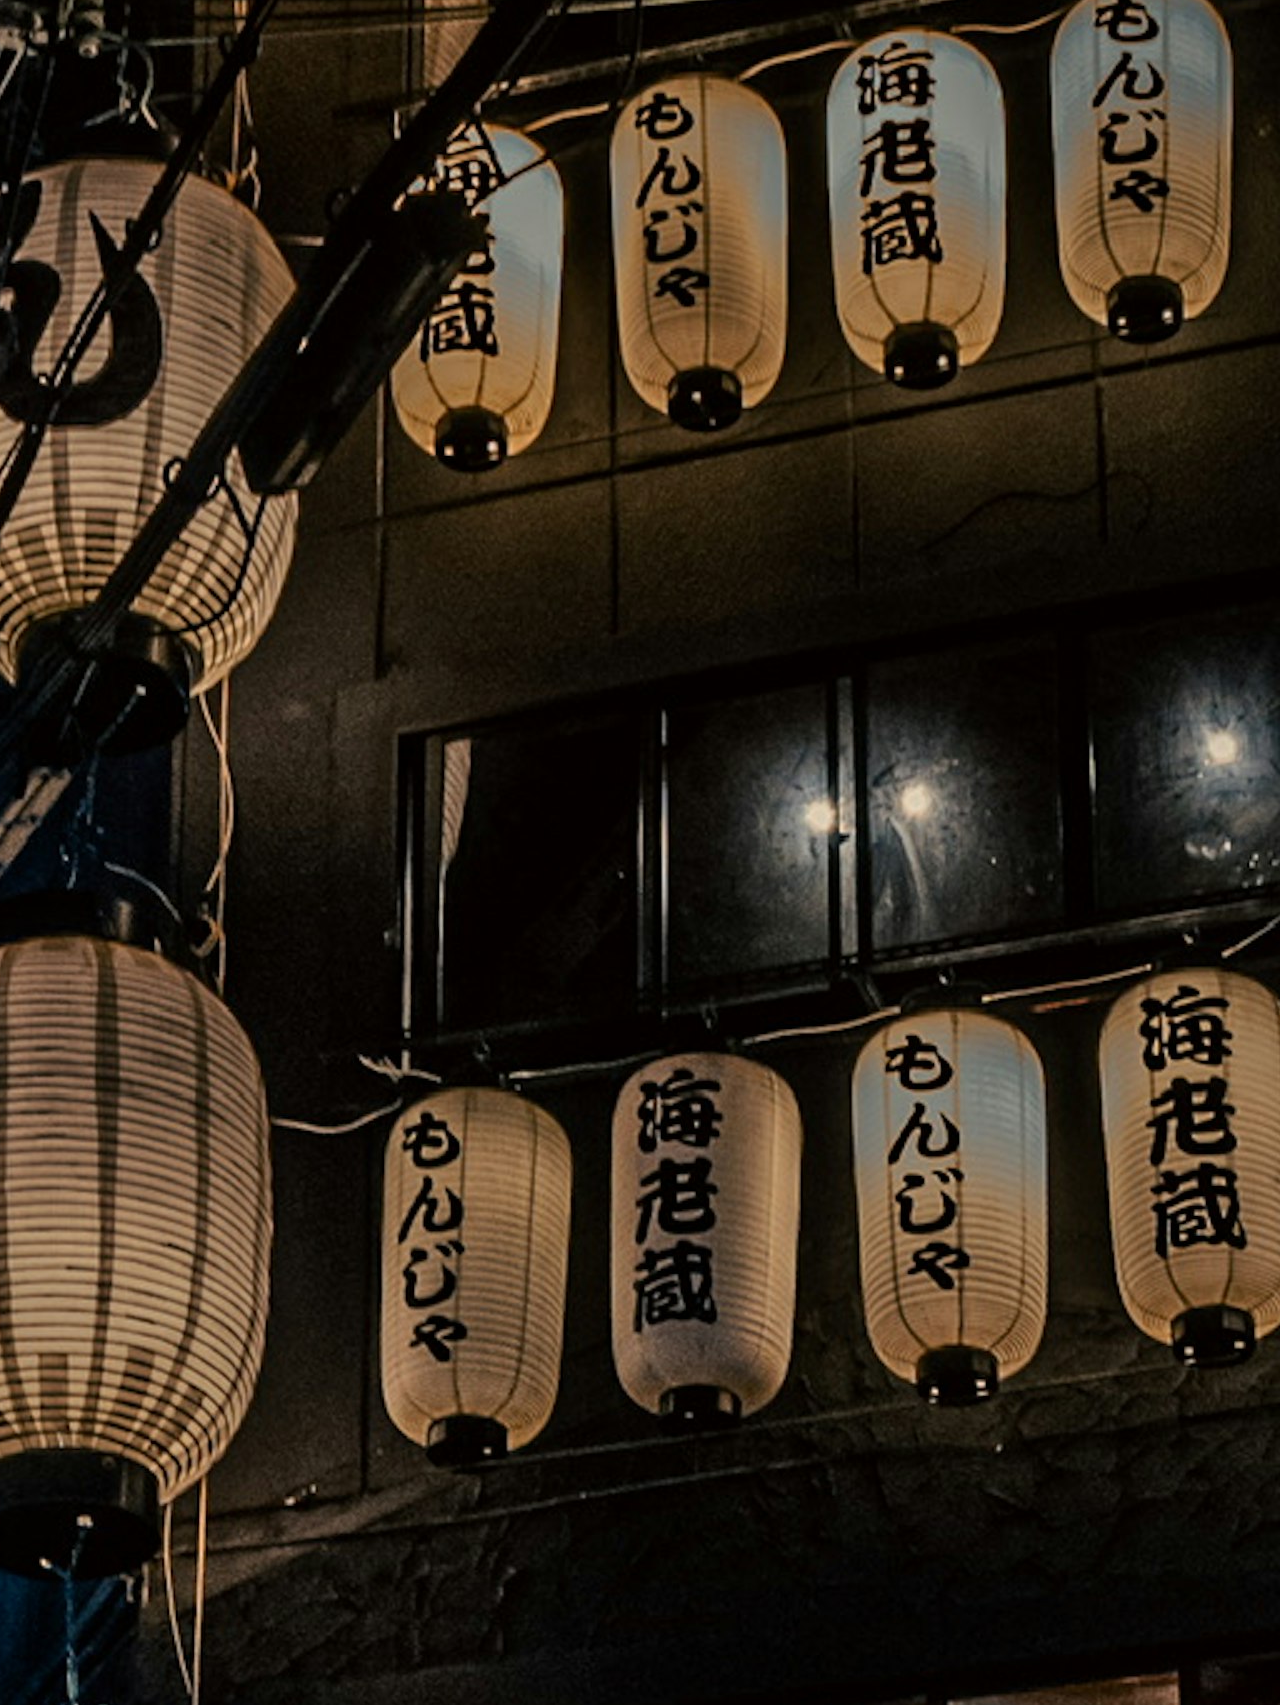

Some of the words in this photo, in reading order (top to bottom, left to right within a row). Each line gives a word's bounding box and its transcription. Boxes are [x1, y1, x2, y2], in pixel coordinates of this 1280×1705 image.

[636, 93, 710, 306] もんじゃ
[856, 42, 942, 275] 海老蔵
[399, 1112, 467, 1362] もんじゃ
[635, 1069, 722, 1332] 海老蔵
[886, 1035, 970, 1290] もんじゃ
[1138, 986, 1247, 1259] 海老蔵
